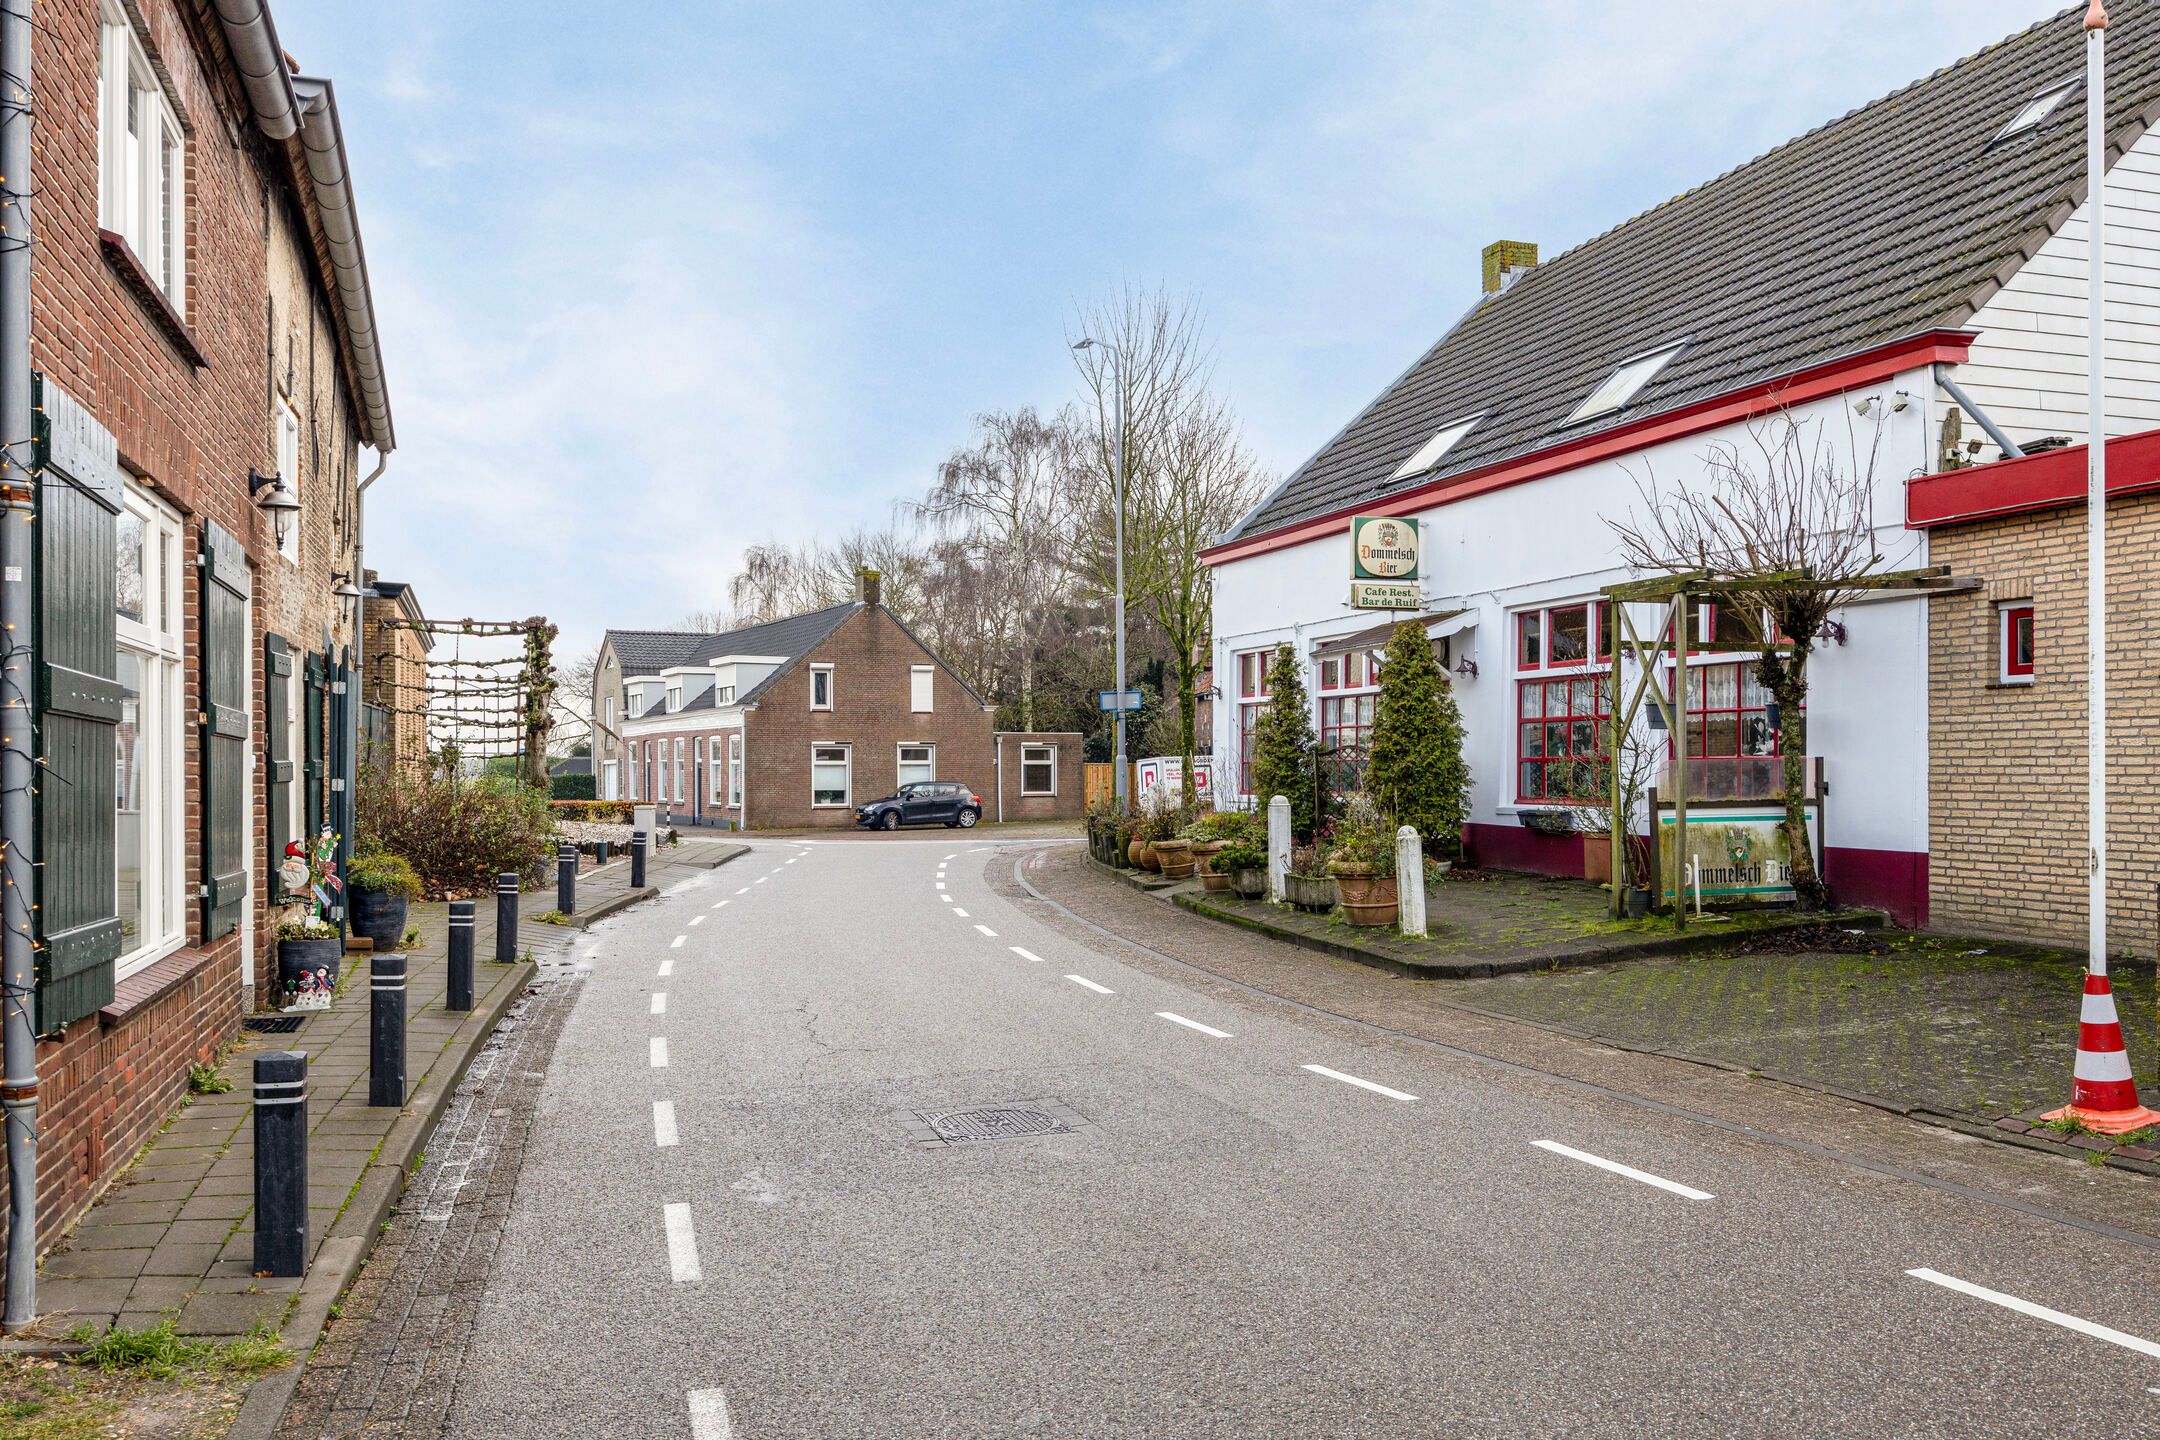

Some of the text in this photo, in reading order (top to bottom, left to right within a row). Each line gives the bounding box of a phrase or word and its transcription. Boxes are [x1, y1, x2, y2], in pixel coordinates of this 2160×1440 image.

[1361, 545, 1415, 563] Dommelsch
[1379, 562, 1398, 574] Bier
[1365, 587, 1415, 597] Cafe Rest.
[1361, 597, 1418, 607] Bar de Ruif
